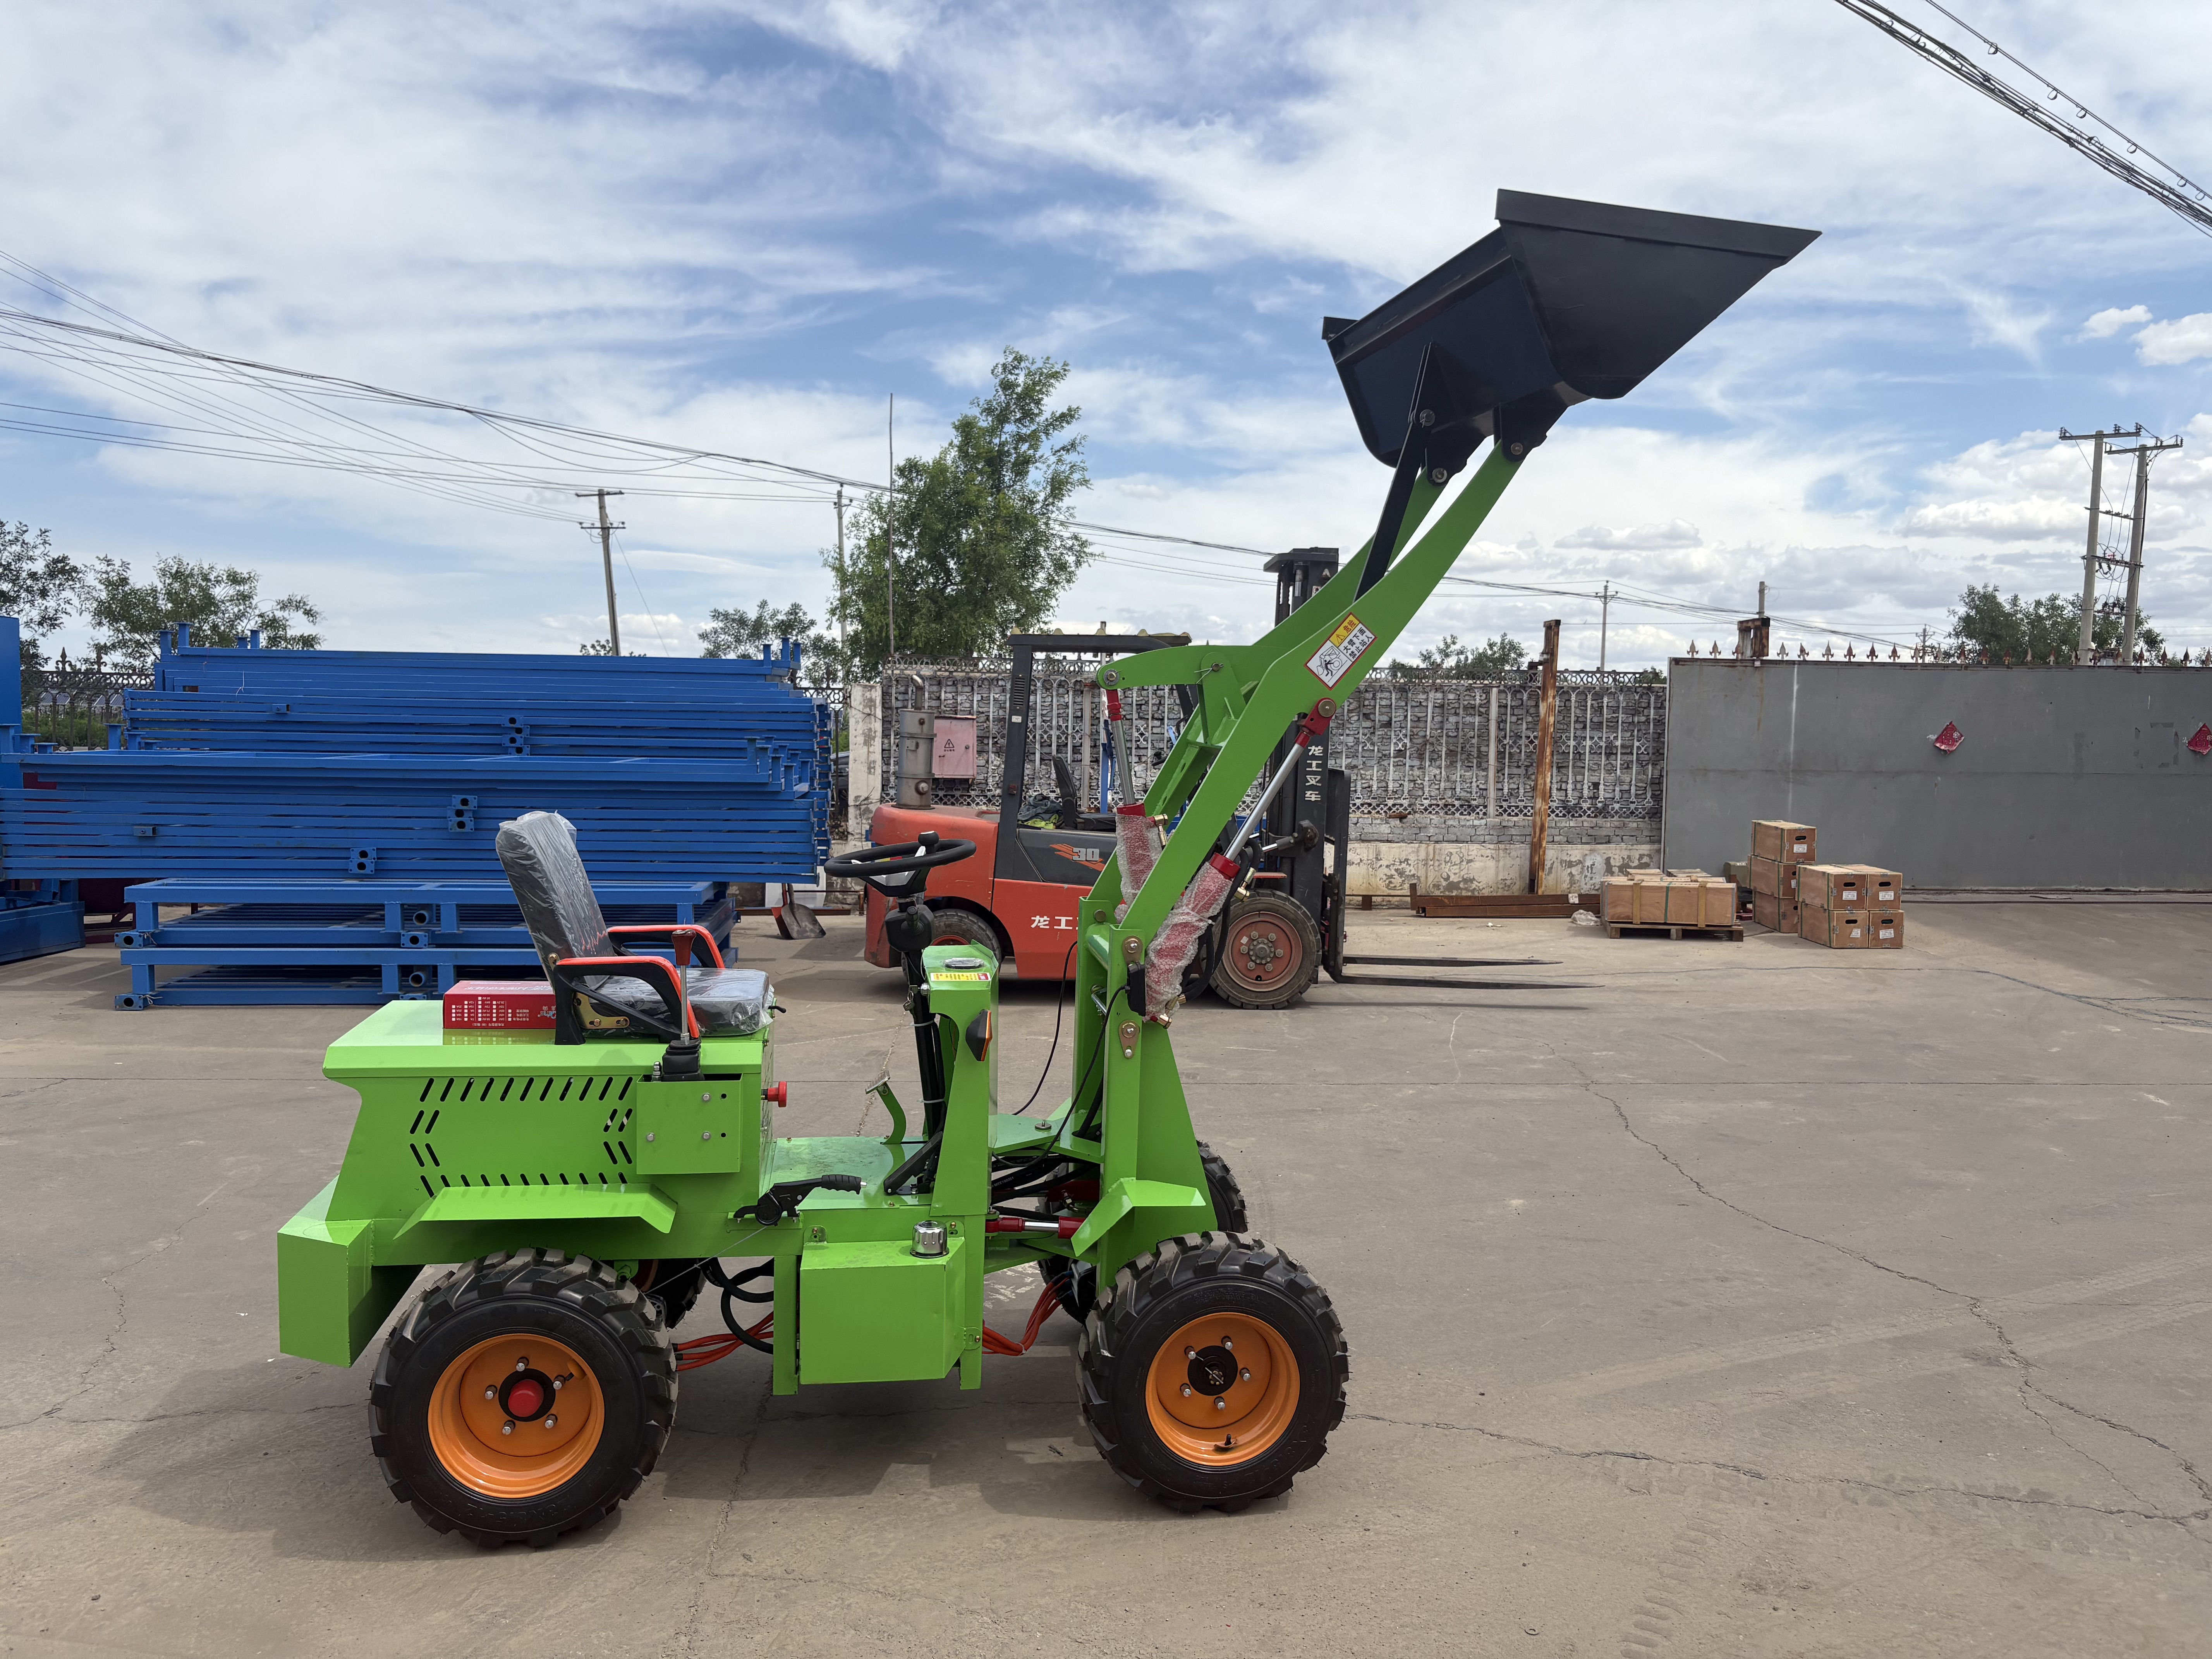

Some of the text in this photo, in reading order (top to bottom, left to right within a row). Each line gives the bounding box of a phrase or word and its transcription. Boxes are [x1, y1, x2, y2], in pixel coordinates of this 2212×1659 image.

[1343, 620, 1357, 634] 危险
[1343, 627, 1366, 654] 大臂下面
[1348, 634, 1372, 660] 禁止站人
[1305, 745, 1324, 801] 龙工叉车
[1072, 847, 1099, 861] 30
[1030, 915, 1079, 930] 龙工
